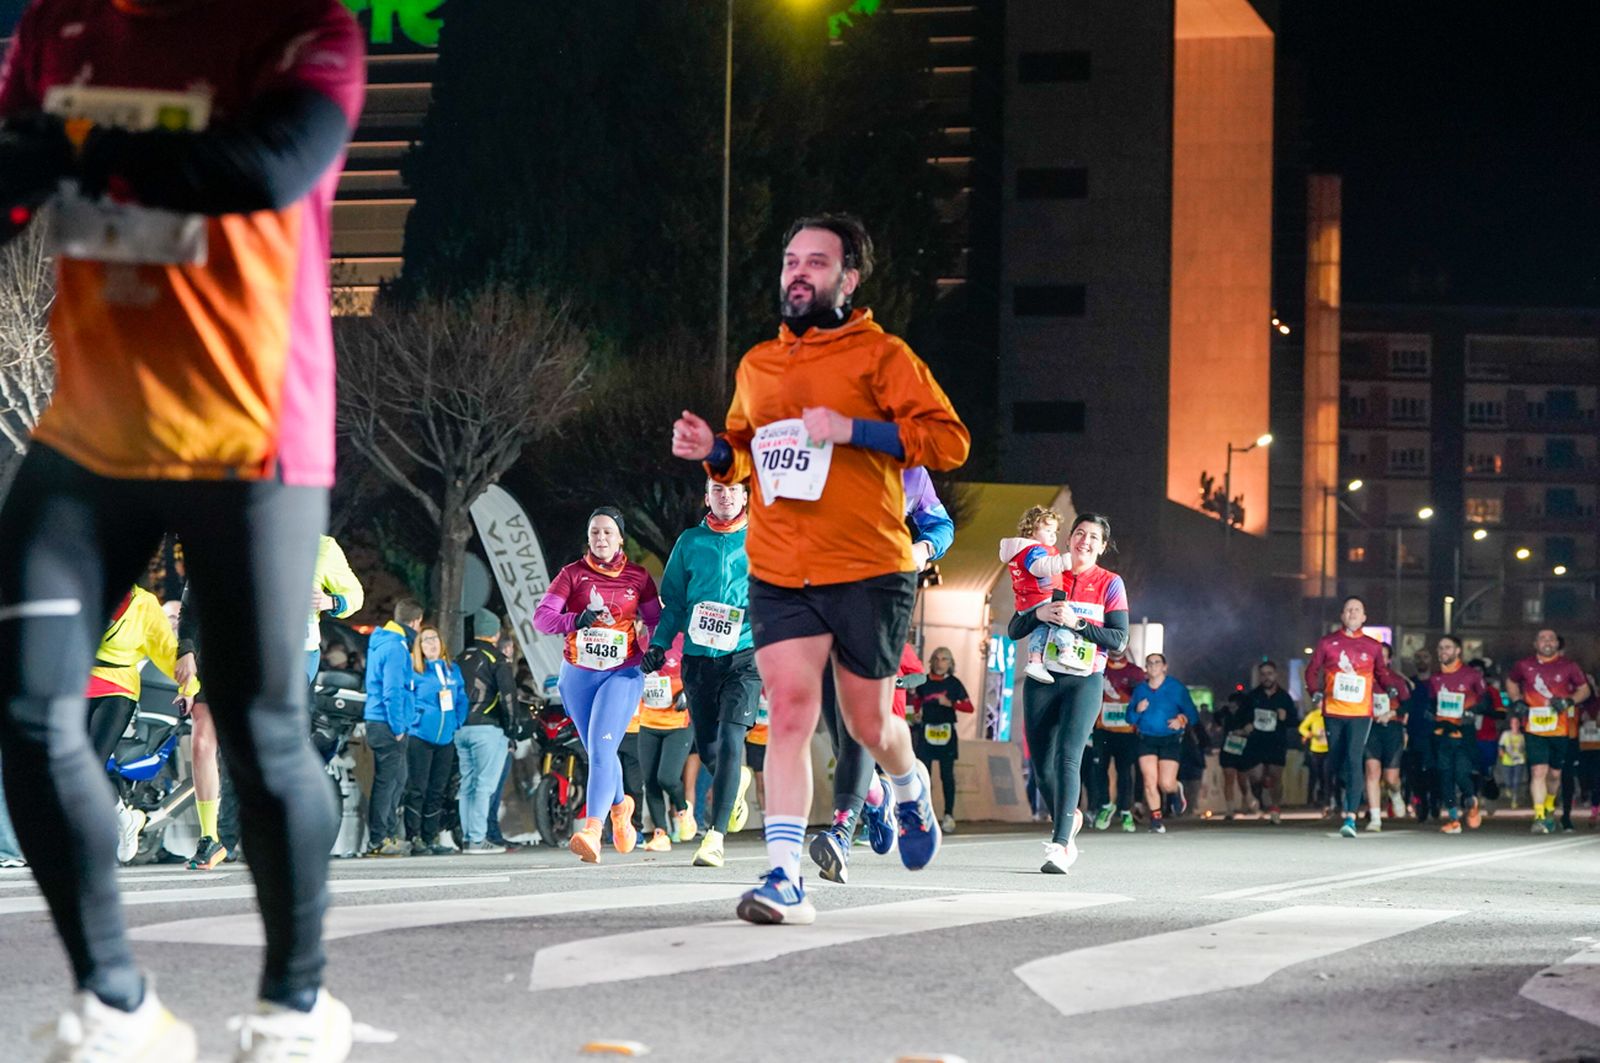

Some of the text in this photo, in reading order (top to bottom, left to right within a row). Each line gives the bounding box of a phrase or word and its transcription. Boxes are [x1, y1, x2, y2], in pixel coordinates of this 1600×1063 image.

[762, 448, 811, 471] 7095
[699, 616, 733, 635] 5365
[585, 642, 618, 658] 5438
